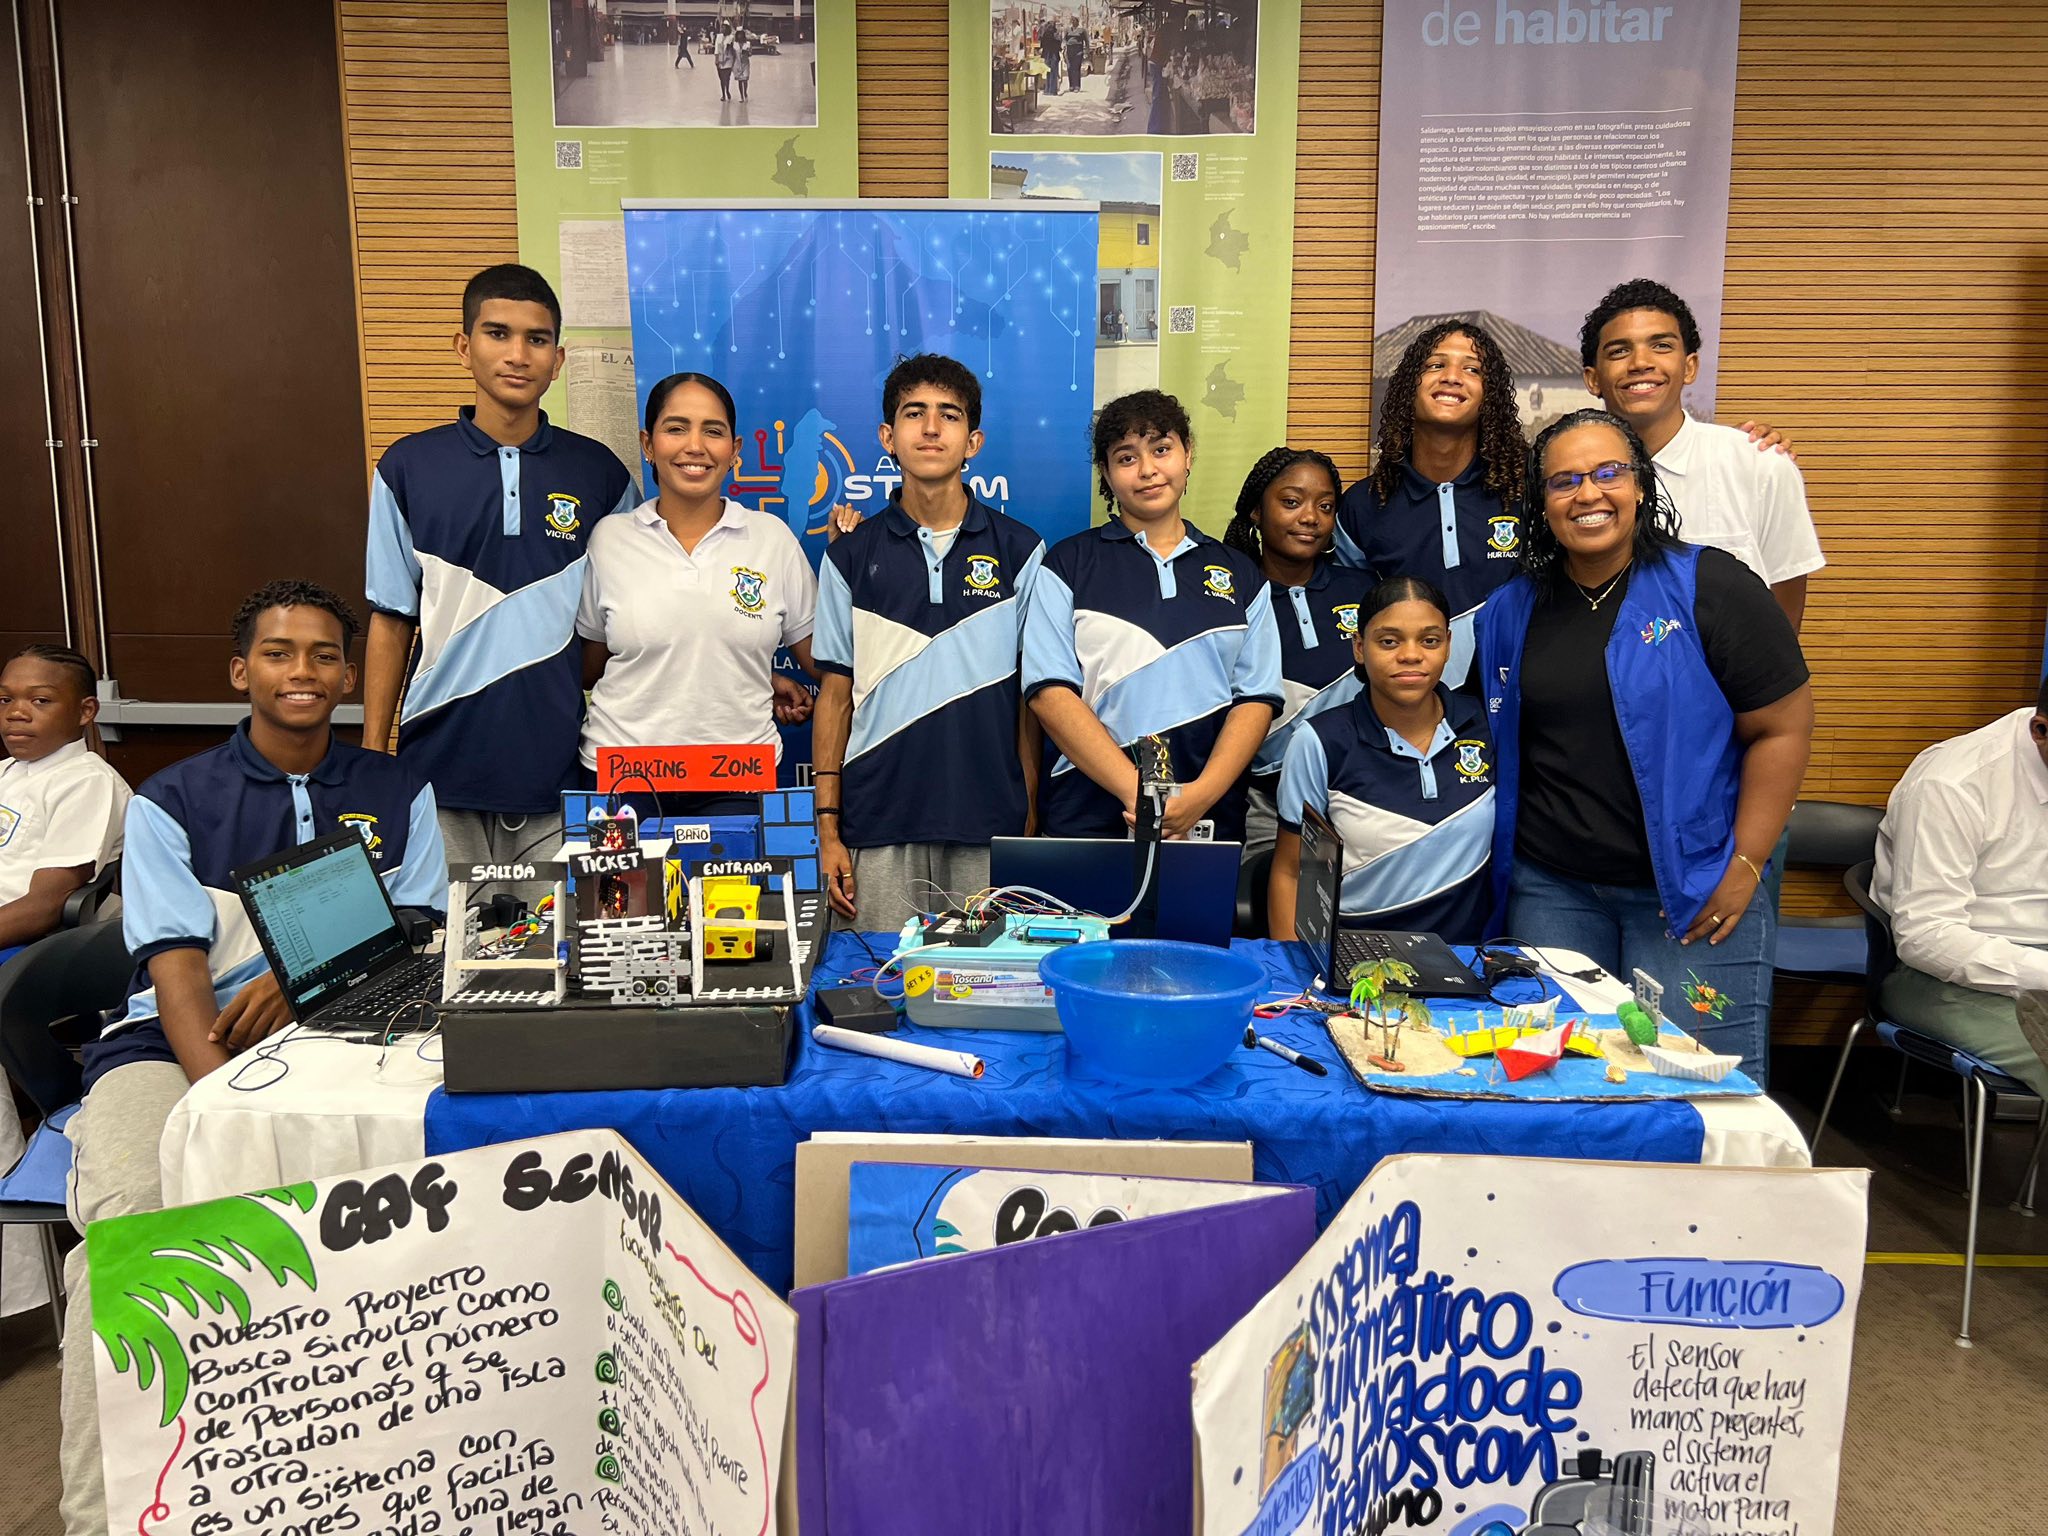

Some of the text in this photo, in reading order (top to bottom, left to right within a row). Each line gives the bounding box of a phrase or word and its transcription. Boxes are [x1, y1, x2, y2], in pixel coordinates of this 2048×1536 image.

[1422, 0, 1673, 46] de habitar
[601, 352, 619, 364] EL
[844, 474, 1009, 501] STM
[545, 529, 577, 541] VICTOR
[1487, 551, 1519, 559] HURTADO
[972, 588, 1001, 599] PRADA
[734, 606, 763, 620] DOCENTE
[608, 754, 764, 779] PARKING ZONE
[578, 852, 640, 874] TICKET
[703, 859, 773, 876] ENTRADA
[906, 978, 918, 991] SET
[925, 970, 932, 978] 5
[953, 974, 995, 985] Toscana
[1638, 1267, 1791, 1318] Función
[382, 1339, 414, 1371] el
[1627, 1332, 1655, 1370] El
[1633, 1368, 1807, 1410] detecta que hay
[194, 1415, 234, 1445] de
[378, 1401, 415, 1432] de
[1631, 1407, 1703, 1435] manos
[1662, 1430, 1773, 1472] el sistema
[521, 1474, 558, 1501] de
[1670, 1464, 1770, 1496] activa el
[244, 1496, 287, 1525] un
[1664, 1494, 1732, 1523] motor
